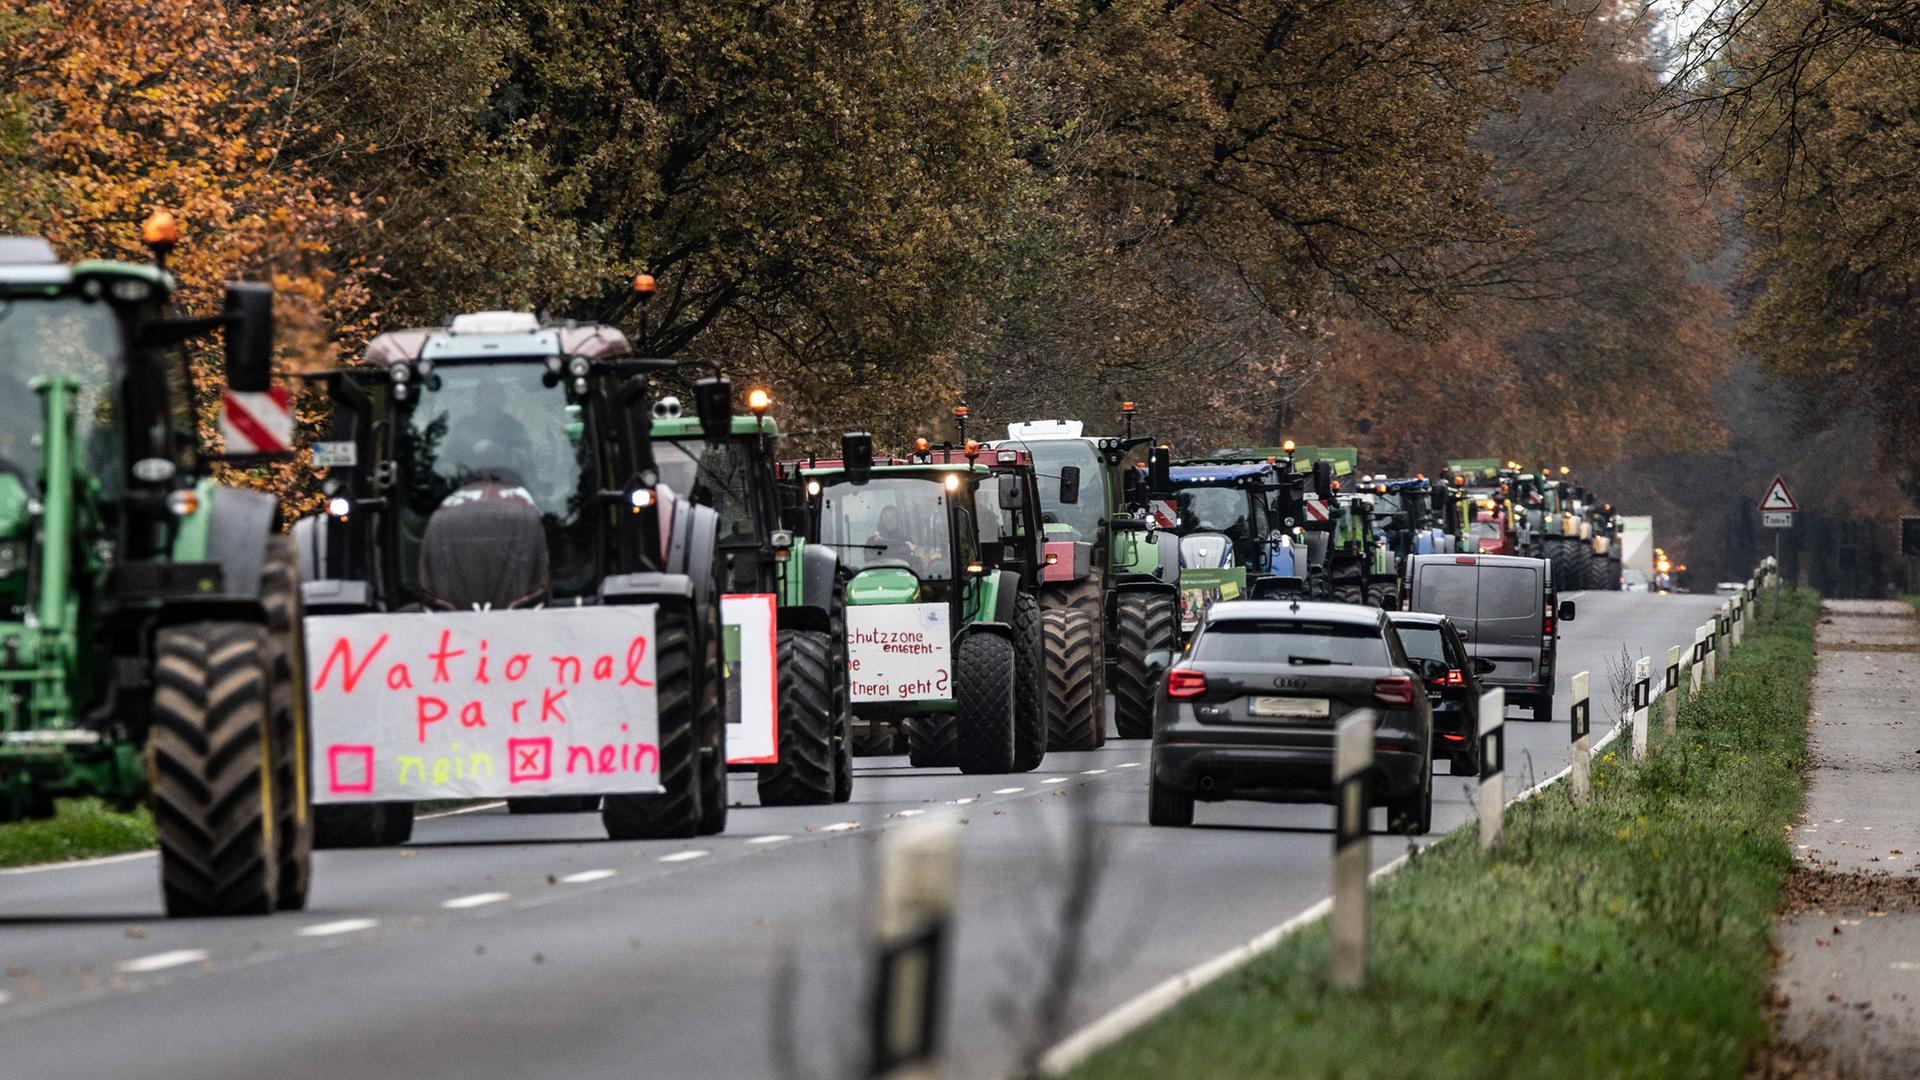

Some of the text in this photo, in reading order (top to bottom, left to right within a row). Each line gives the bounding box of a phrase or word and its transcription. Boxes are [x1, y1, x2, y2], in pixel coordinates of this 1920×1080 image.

[313, 628, 655, 692] National
[397, 723, 659, 786] nein nein
